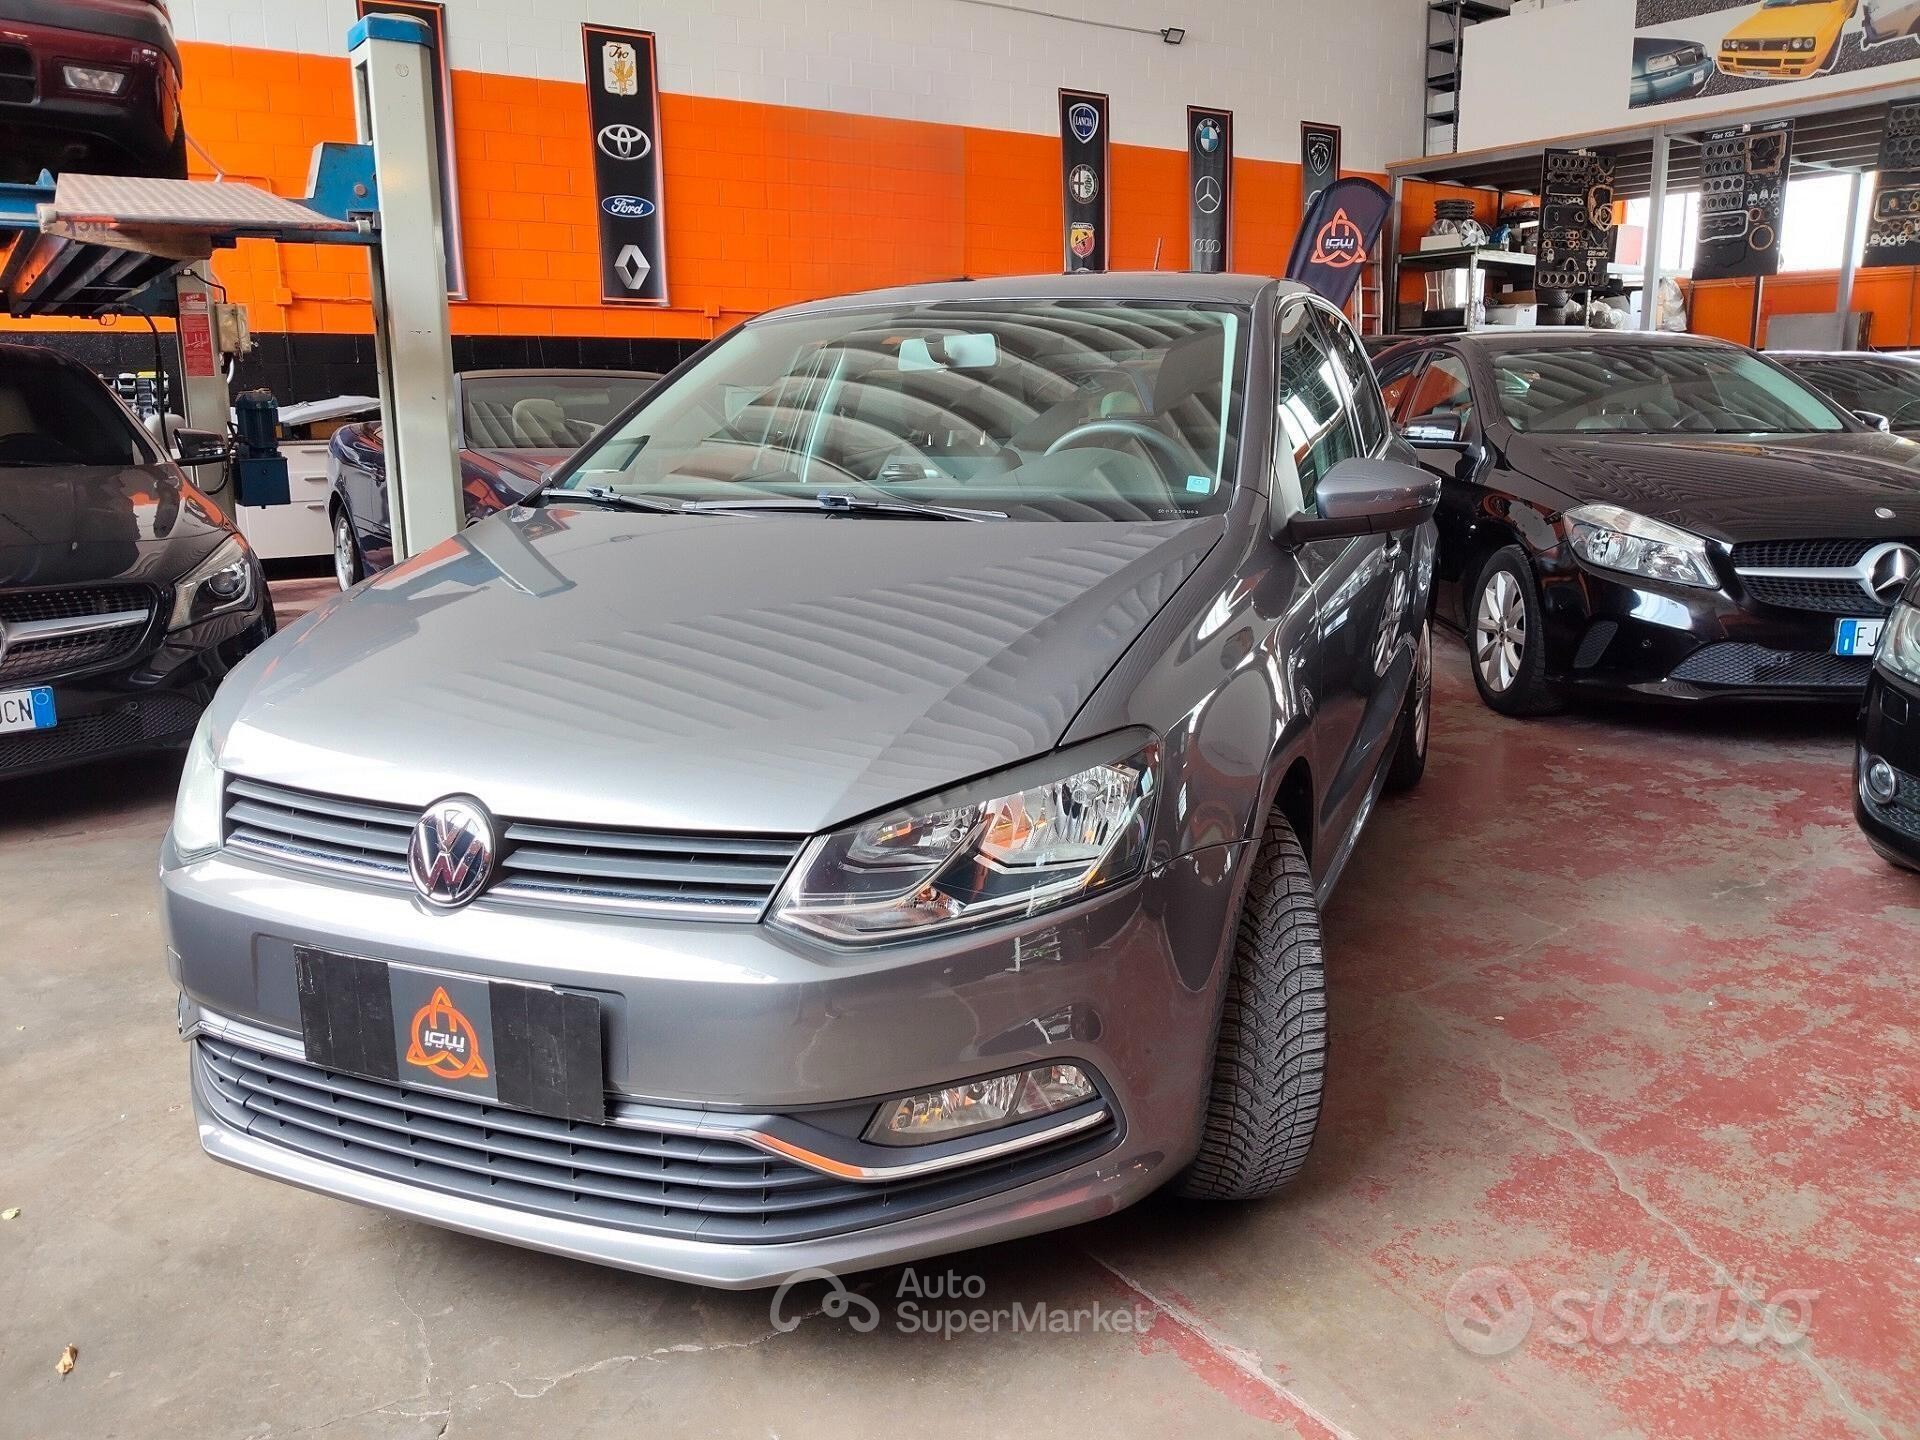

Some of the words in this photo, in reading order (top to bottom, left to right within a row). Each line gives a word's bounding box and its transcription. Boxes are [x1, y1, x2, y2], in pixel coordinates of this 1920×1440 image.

[1075, 116, 1093, 127] LANCIA
[1198, 119, 1221, 133] BMW
[611, 198, 644, 214] Ford
[1325, 238, 1355, 247] IGW
[0, 698, 33, 725] CN
[424, 1030, 465, 1048] IGW
